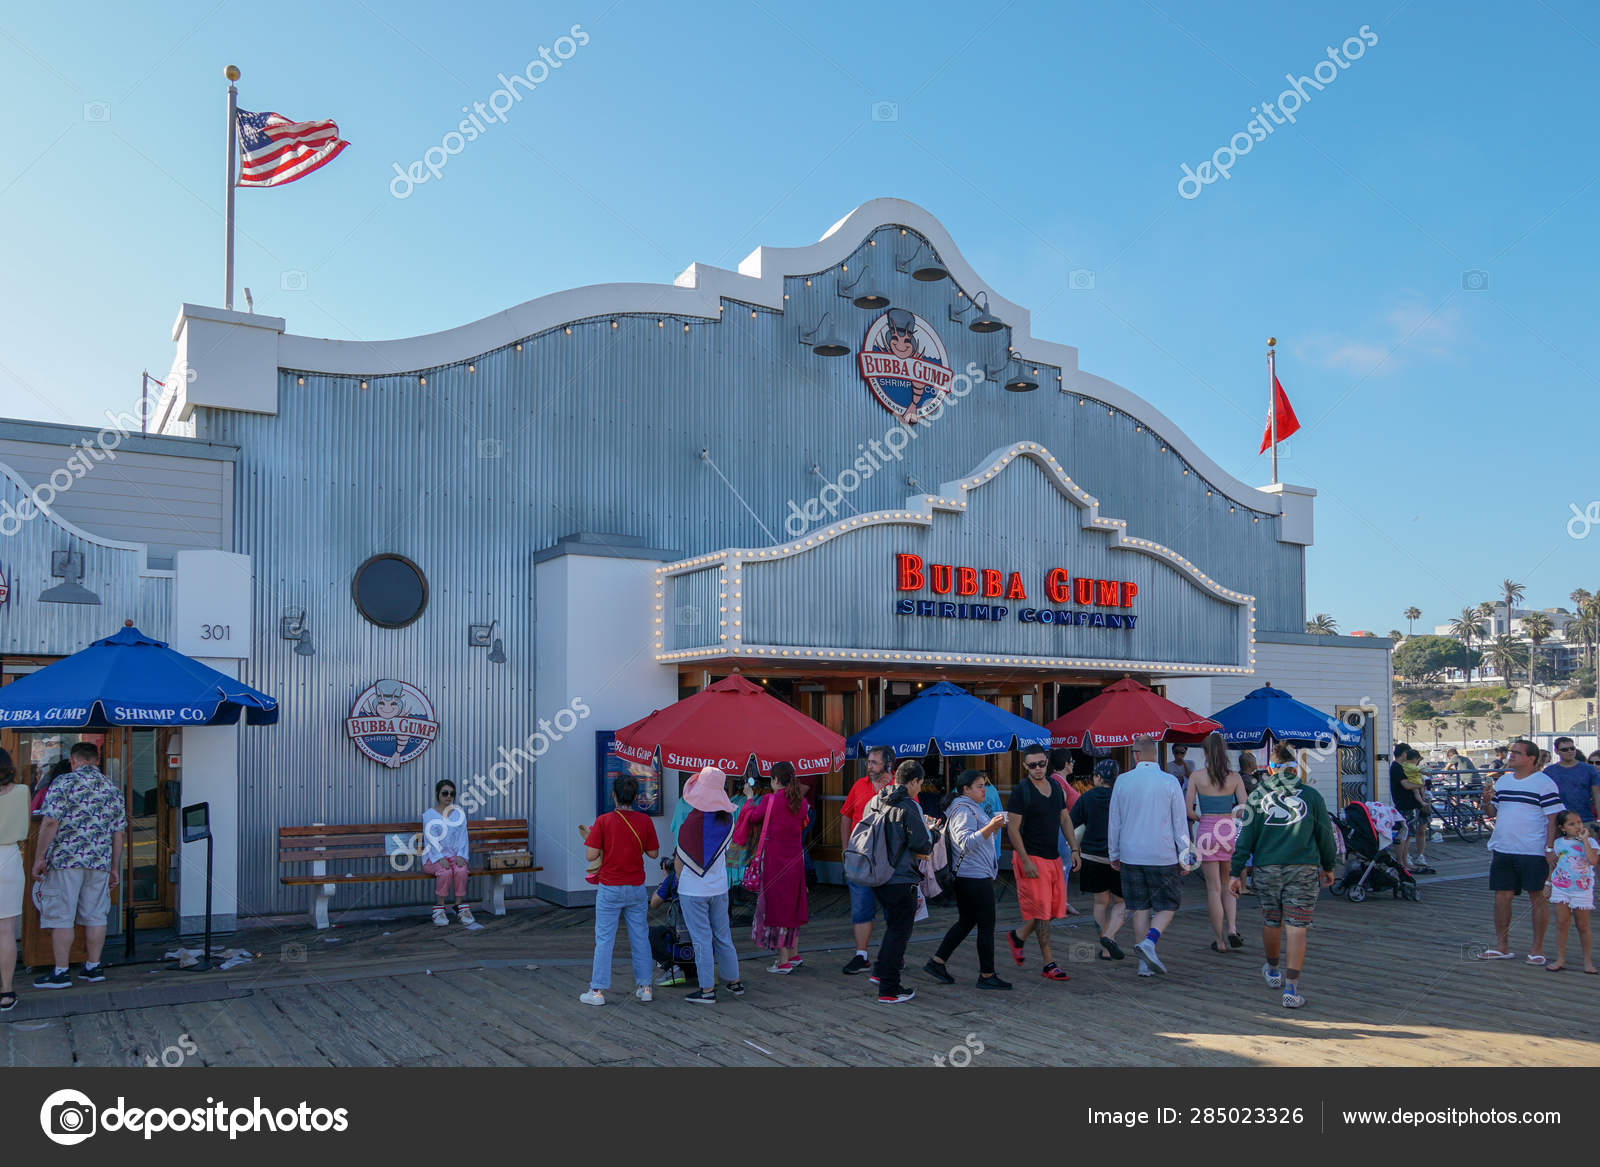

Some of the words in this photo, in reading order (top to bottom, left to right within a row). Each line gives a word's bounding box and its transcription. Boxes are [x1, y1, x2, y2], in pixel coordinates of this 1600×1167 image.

[864, 355, 910, 376] BUBBA
[913, 361, 950, 387] GUMP
[880, 378, 911, 388] SHRIMP
[896, 553, 1026, 600] BUBBA
[1045, 567, 1138, 608] GUMP
[897, 599, 1008, 622] SHRIMP
[1018, 607, 1138, 629] COMPANY
[201, 624, 230, 640] 301
[44, 707, 87, 720] GUMP
[114, 707, 175, 720] SHRIMP
[179, 707, 206, 720] CO.
[352, 720, 396, 734] BUBBA
[399, 718, 435, 737] GUMP
[1094, 734, 1128, 743] BUBBA
[1236, 731, 1261, 739] GUMP
[899, 743, 926, 753] GUMP
[944, 740, 984, 751] SHRIMP
[987, 739, 1006, 749] CO.
[667, 753, 714, 768] SHRIMP
[718, 758, 739, 770] CO.
[798, 757, 831, 770] GUMP
